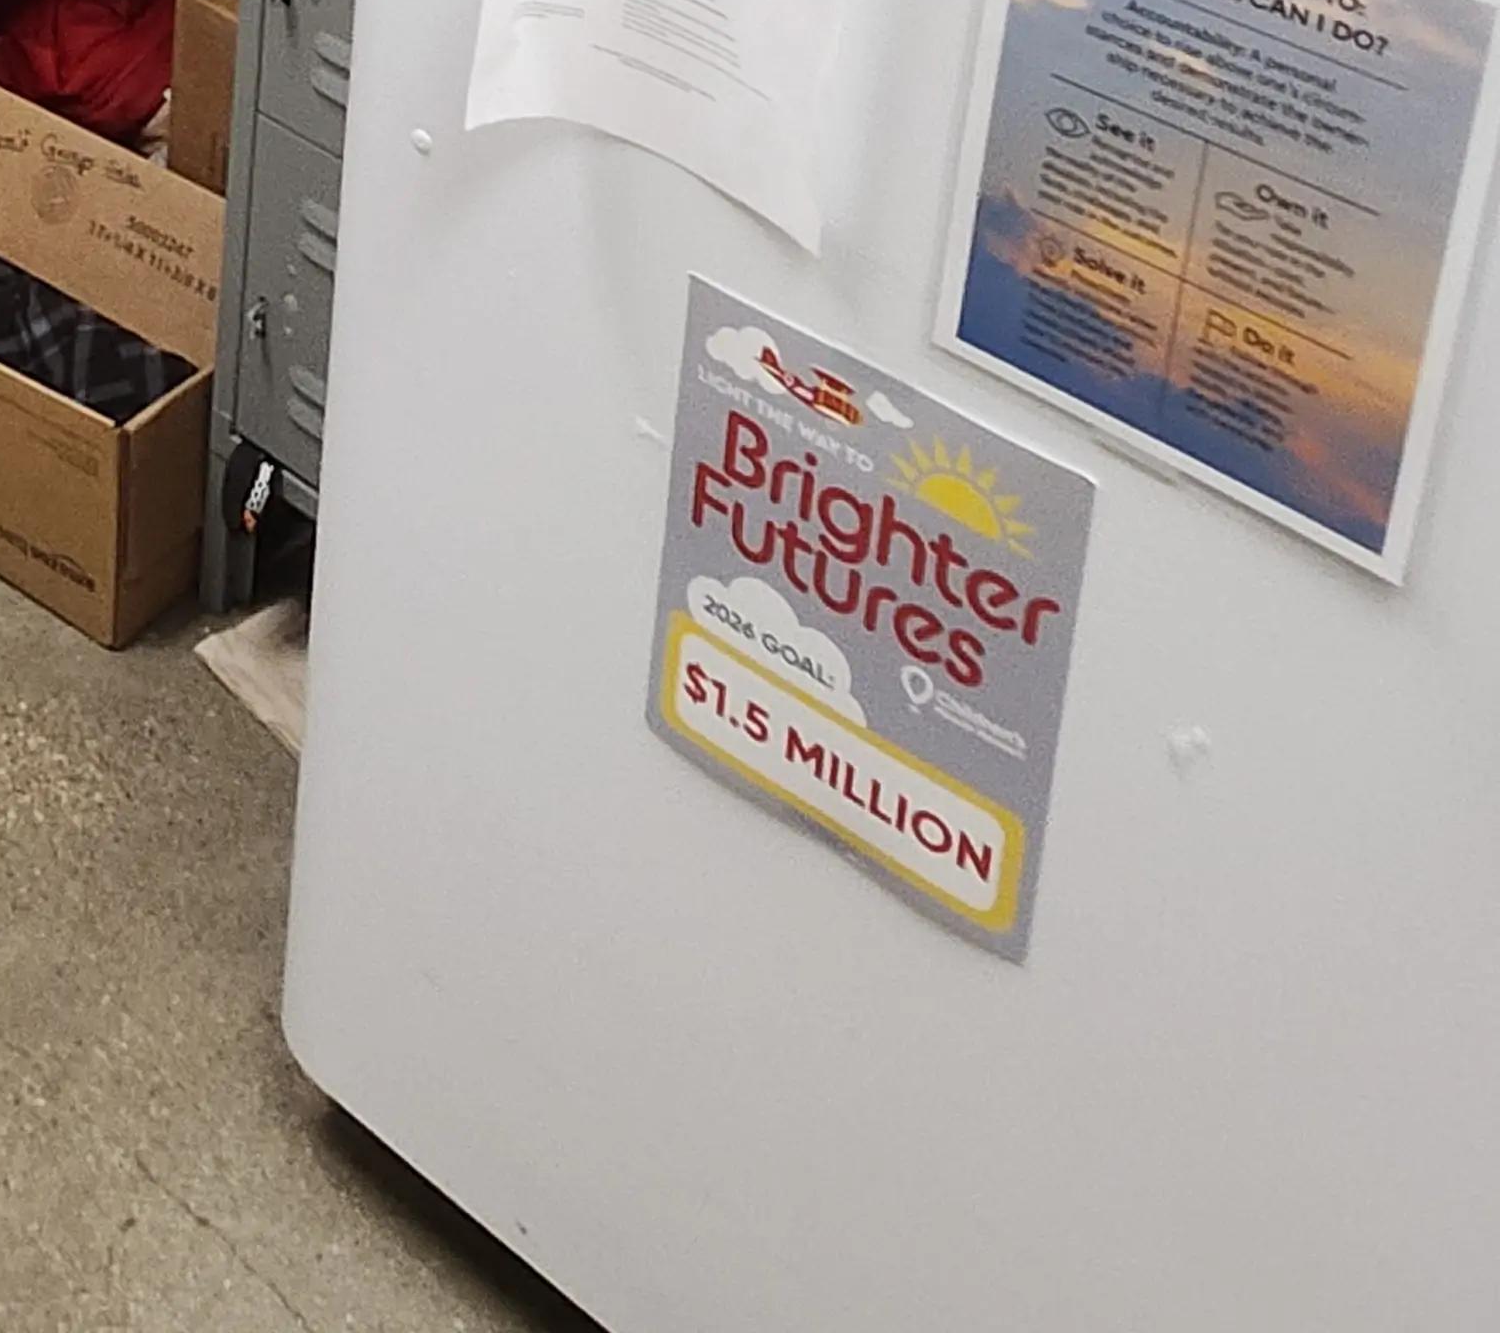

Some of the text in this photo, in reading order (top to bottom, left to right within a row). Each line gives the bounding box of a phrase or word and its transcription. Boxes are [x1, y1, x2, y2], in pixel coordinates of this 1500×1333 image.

[1316, 14, 1325, 31] I
[1331, 21, 1389, 57] DO?
[1095, 114, 1156, 152] See it
[1256, 183, 1329, 230] Own it
[1074, 246, 1147, 295] Solve it
[1243, 326, 1296, 367] Do it
[698, 364, 874, 472] LIGHT THE WAY TO
[721, 410, 1062, 647] Brighter
[690, 461, 987, 689] Futures
[703, 593, 837, 692] 2026 GOAL:
[684, 662, 772, 744] $1.5
[783, 725, 994, 883] MILLION
